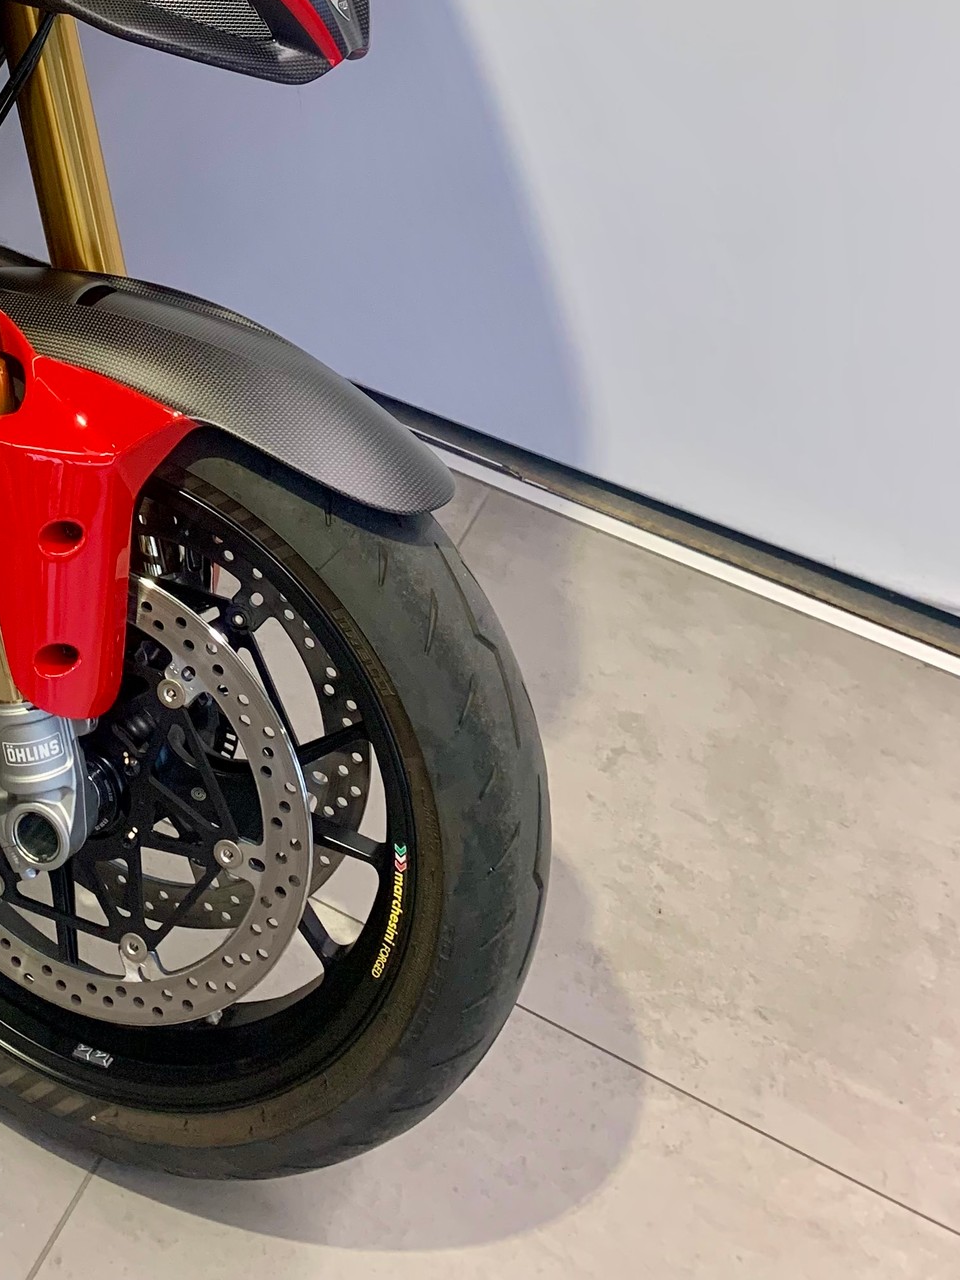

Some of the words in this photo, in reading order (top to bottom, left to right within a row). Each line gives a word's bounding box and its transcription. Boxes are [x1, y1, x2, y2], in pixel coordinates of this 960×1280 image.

[5, 739, 60, 763] ÖHLINS
[383, 870, 404, 947] marchesini
[371, 942, 391, 979] FORGED
